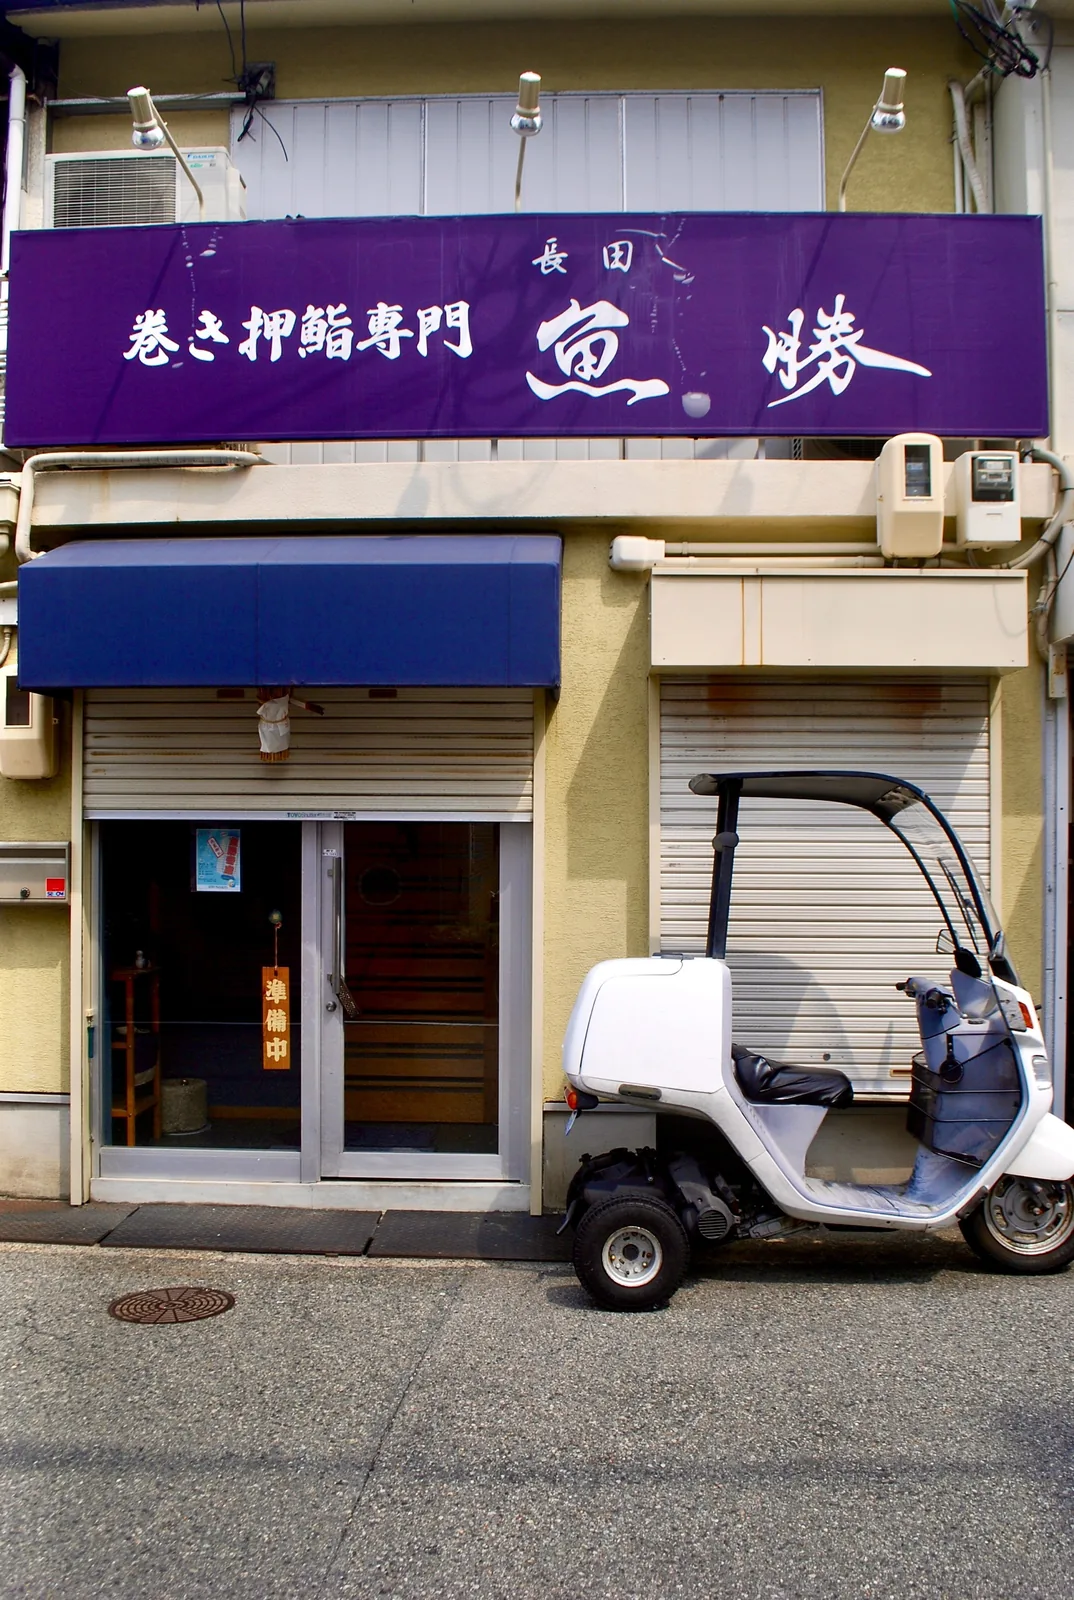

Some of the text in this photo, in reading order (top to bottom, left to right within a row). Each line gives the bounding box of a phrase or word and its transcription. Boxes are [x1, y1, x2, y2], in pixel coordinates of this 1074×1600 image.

[531, 237, 634, 275] 長田
[122, 300, 474, 367] 巻き押鮨専門
[265, 978, 288, 1062] 準備中
